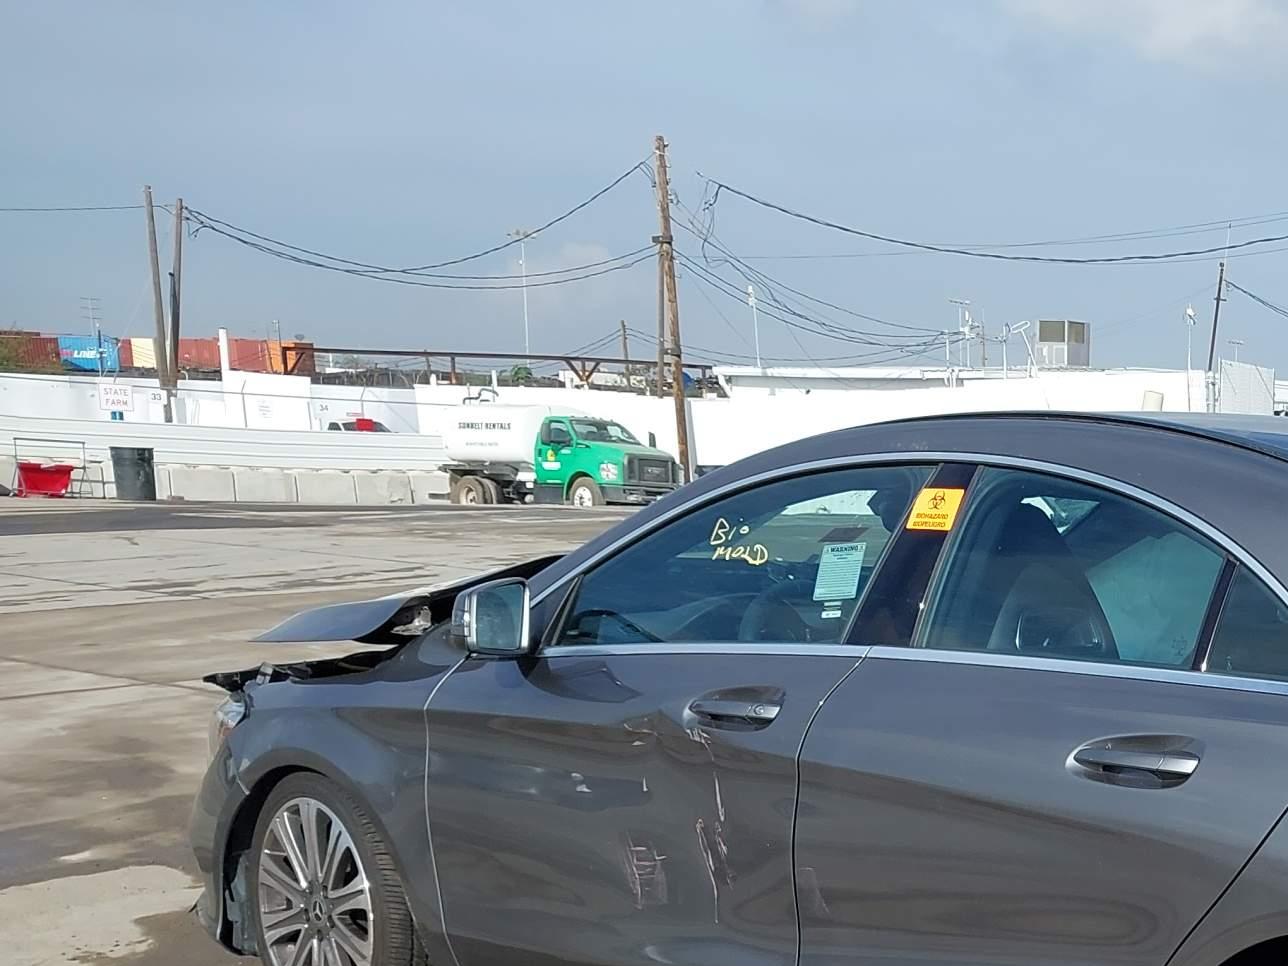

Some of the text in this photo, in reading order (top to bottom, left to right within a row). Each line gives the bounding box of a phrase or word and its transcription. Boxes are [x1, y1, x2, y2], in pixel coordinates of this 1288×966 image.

[103, 387, 129, 397] STATE
[151, 393, 162, 401] 33
[105, 398, 128, 407] FARM
[319, 404, 329, 412] 34
[485, 422, 511, 430] RENTALS
[830, 545, 859, 553] WARNING
